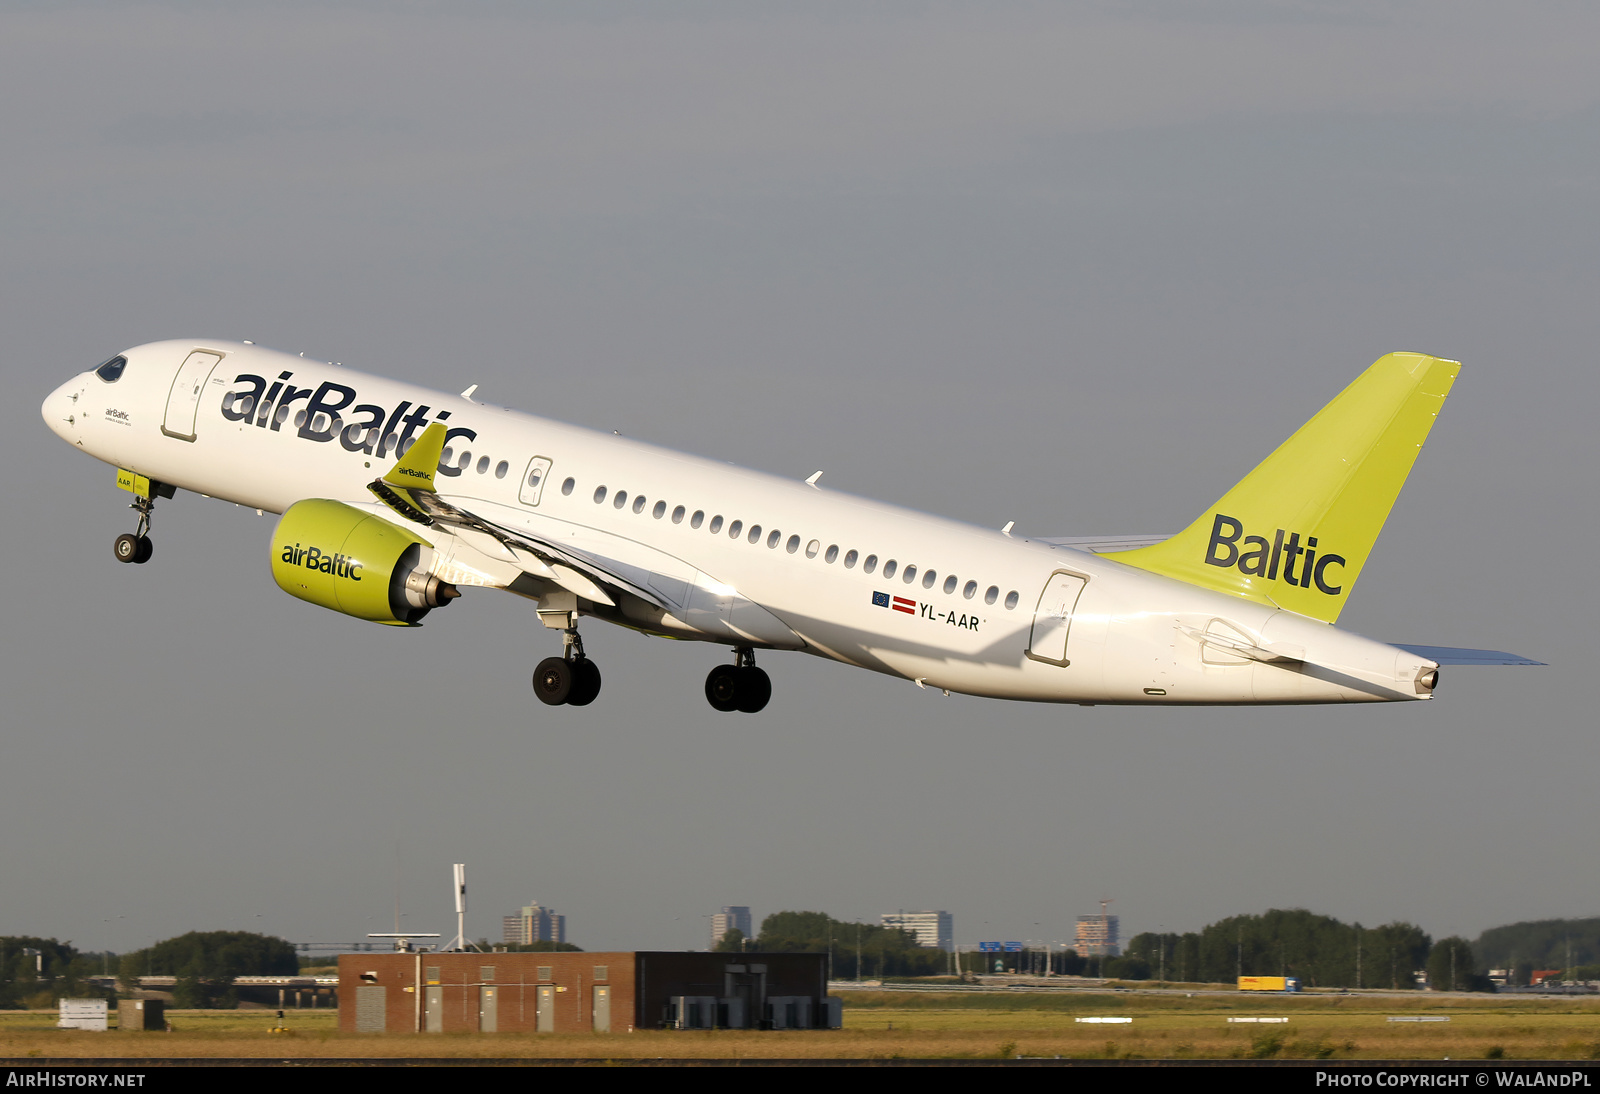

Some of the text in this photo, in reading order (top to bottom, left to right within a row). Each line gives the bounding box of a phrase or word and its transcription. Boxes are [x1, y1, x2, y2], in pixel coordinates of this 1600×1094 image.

[105, 407, 130, 421] airBaltic
[221, 370, 477, 477] airBaltc
[117, 477, 131, 487] AAR
[398, 466, 432, 481] airBaltic
[281, 542, 363, 582] airBaltic
[1204, 513, 1346, 595] Baltic
[919, 602, 980, 632] YL-AAR
